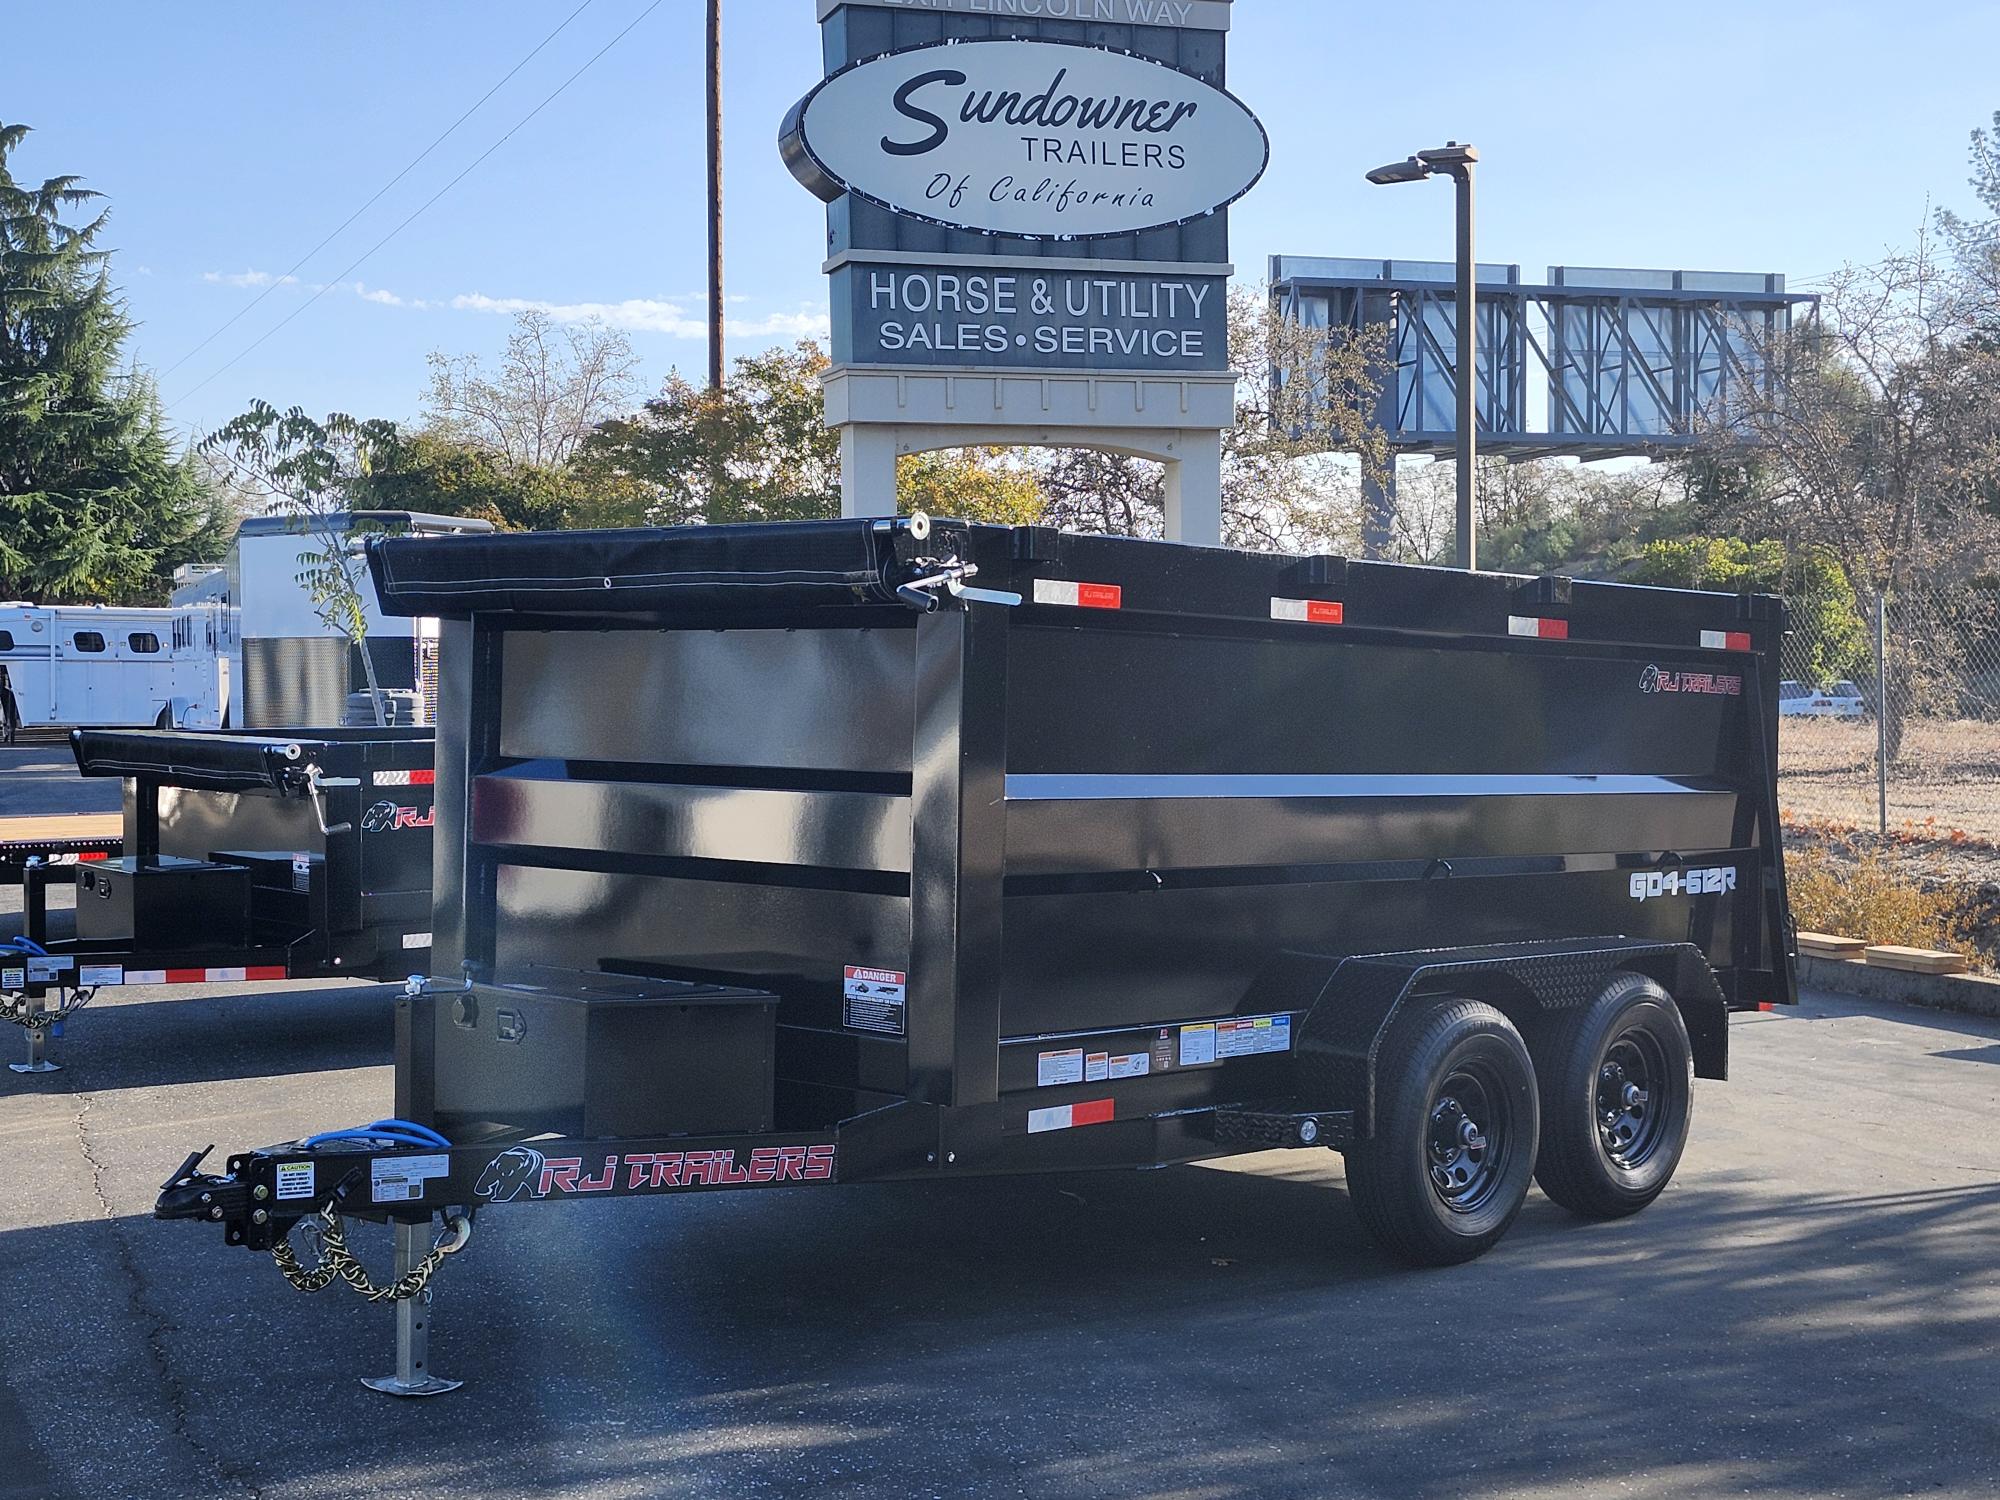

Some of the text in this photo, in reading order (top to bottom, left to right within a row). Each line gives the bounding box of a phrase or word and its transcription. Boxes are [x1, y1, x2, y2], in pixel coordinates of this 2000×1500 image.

[1126, 0, 1193, 25] WAY
[880, 68, 1198, 156] Sundowner
[1021, 136, 1186, 169] TRAILERS
[925, 173, 1155, 213] Of California
[870, 272, 1210, 319] HORSE & UTILITY
[1657, 671, 1741, 695] RJ TRAILERS
[395, 805, 435, 828] RJ
[1629, 866, 1737, 903] GD4-612R
[863, 970, 897, 983] DANGER
[538, 1144, 835, 1193] RJ TRAILERS
